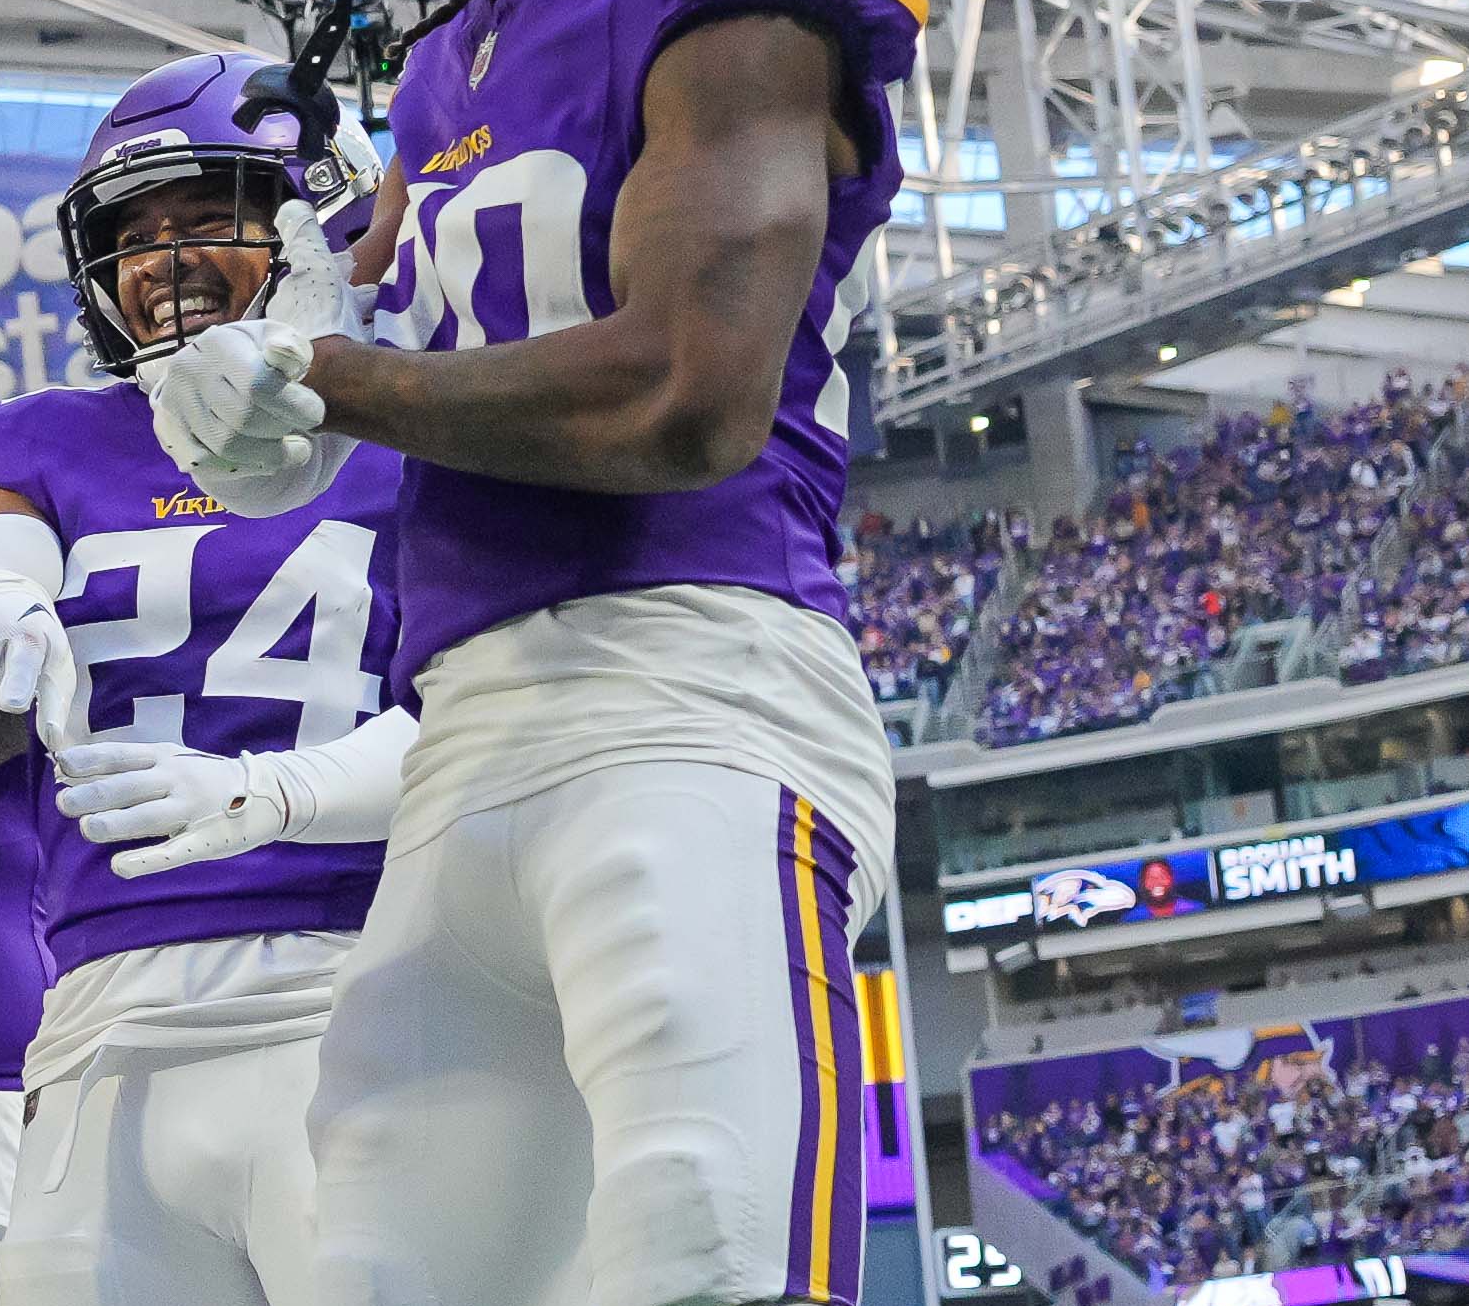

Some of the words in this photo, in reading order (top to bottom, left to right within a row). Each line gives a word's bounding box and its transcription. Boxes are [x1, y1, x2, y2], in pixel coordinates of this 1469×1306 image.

[54, 518, 385, 752] 24
[1223, 847, 1357, 901] SMITH
[943, 892, 1034, 934] DEF
